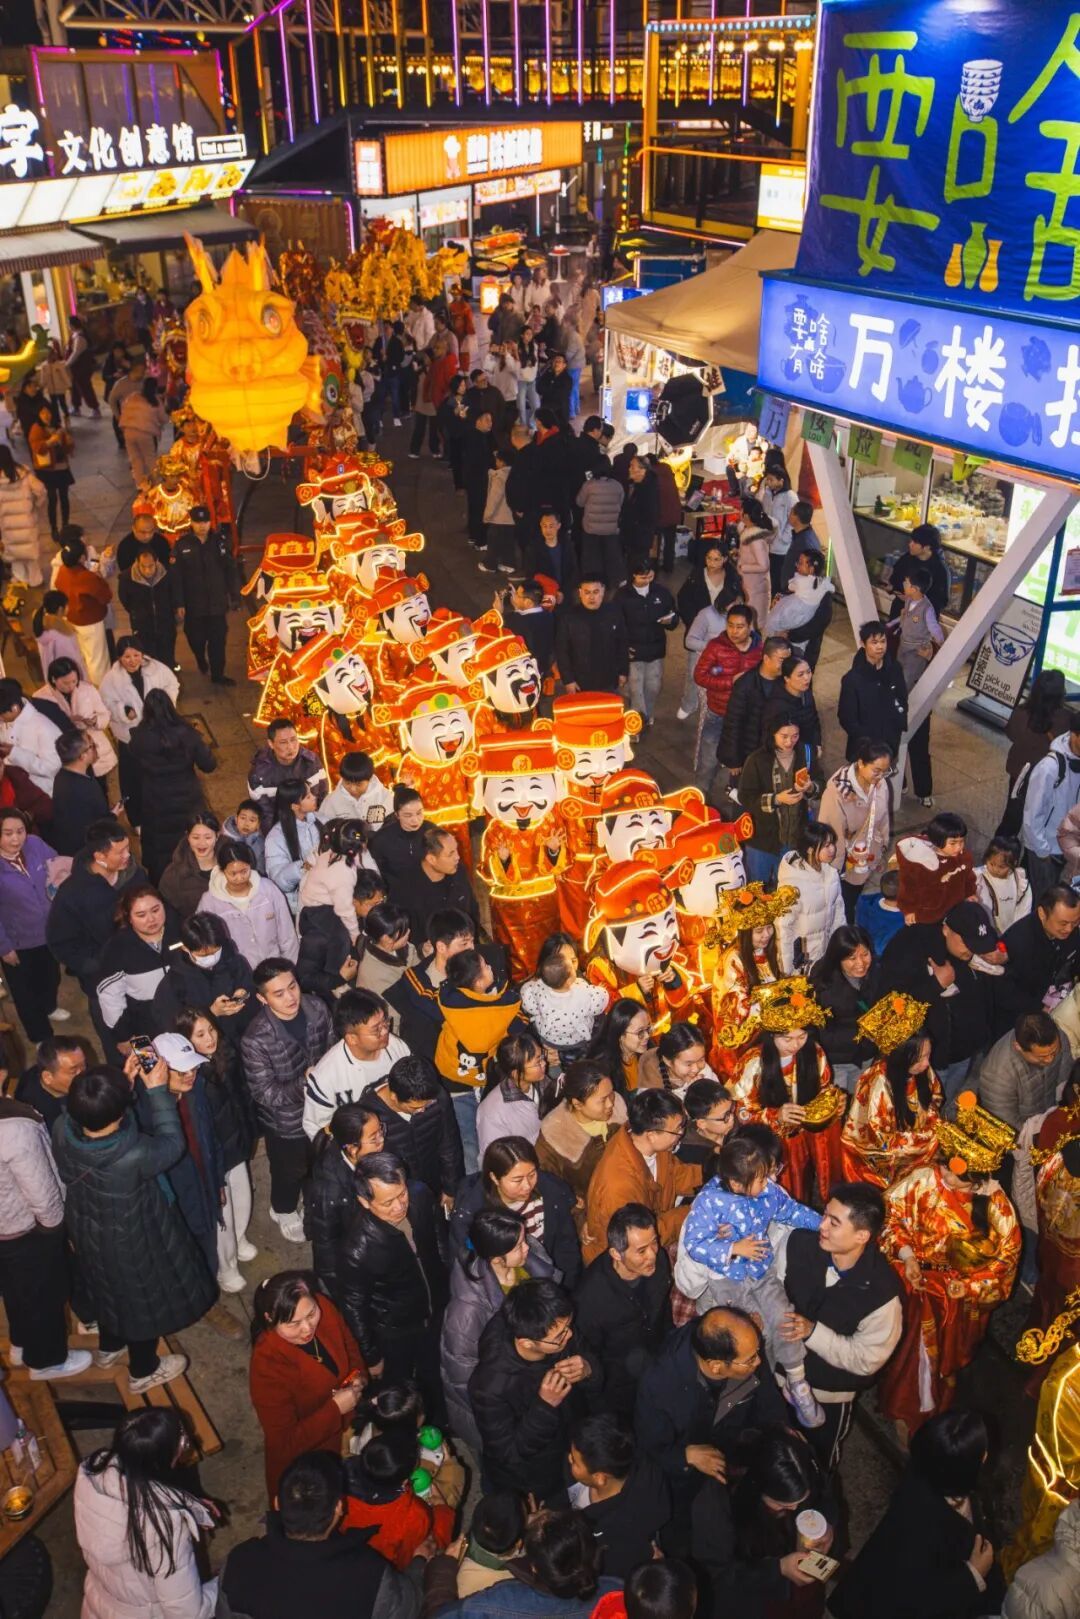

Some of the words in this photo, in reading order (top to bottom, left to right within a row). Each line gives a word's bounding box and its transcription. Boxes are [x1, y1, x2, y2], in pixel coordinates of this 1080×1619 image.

[57, 121, 195, 175] 文化创意馆
[982, 682, 1016, 704] porcelain
[984, 673, 1000, 687] pick
[1000, 682, 1011, 692] up
